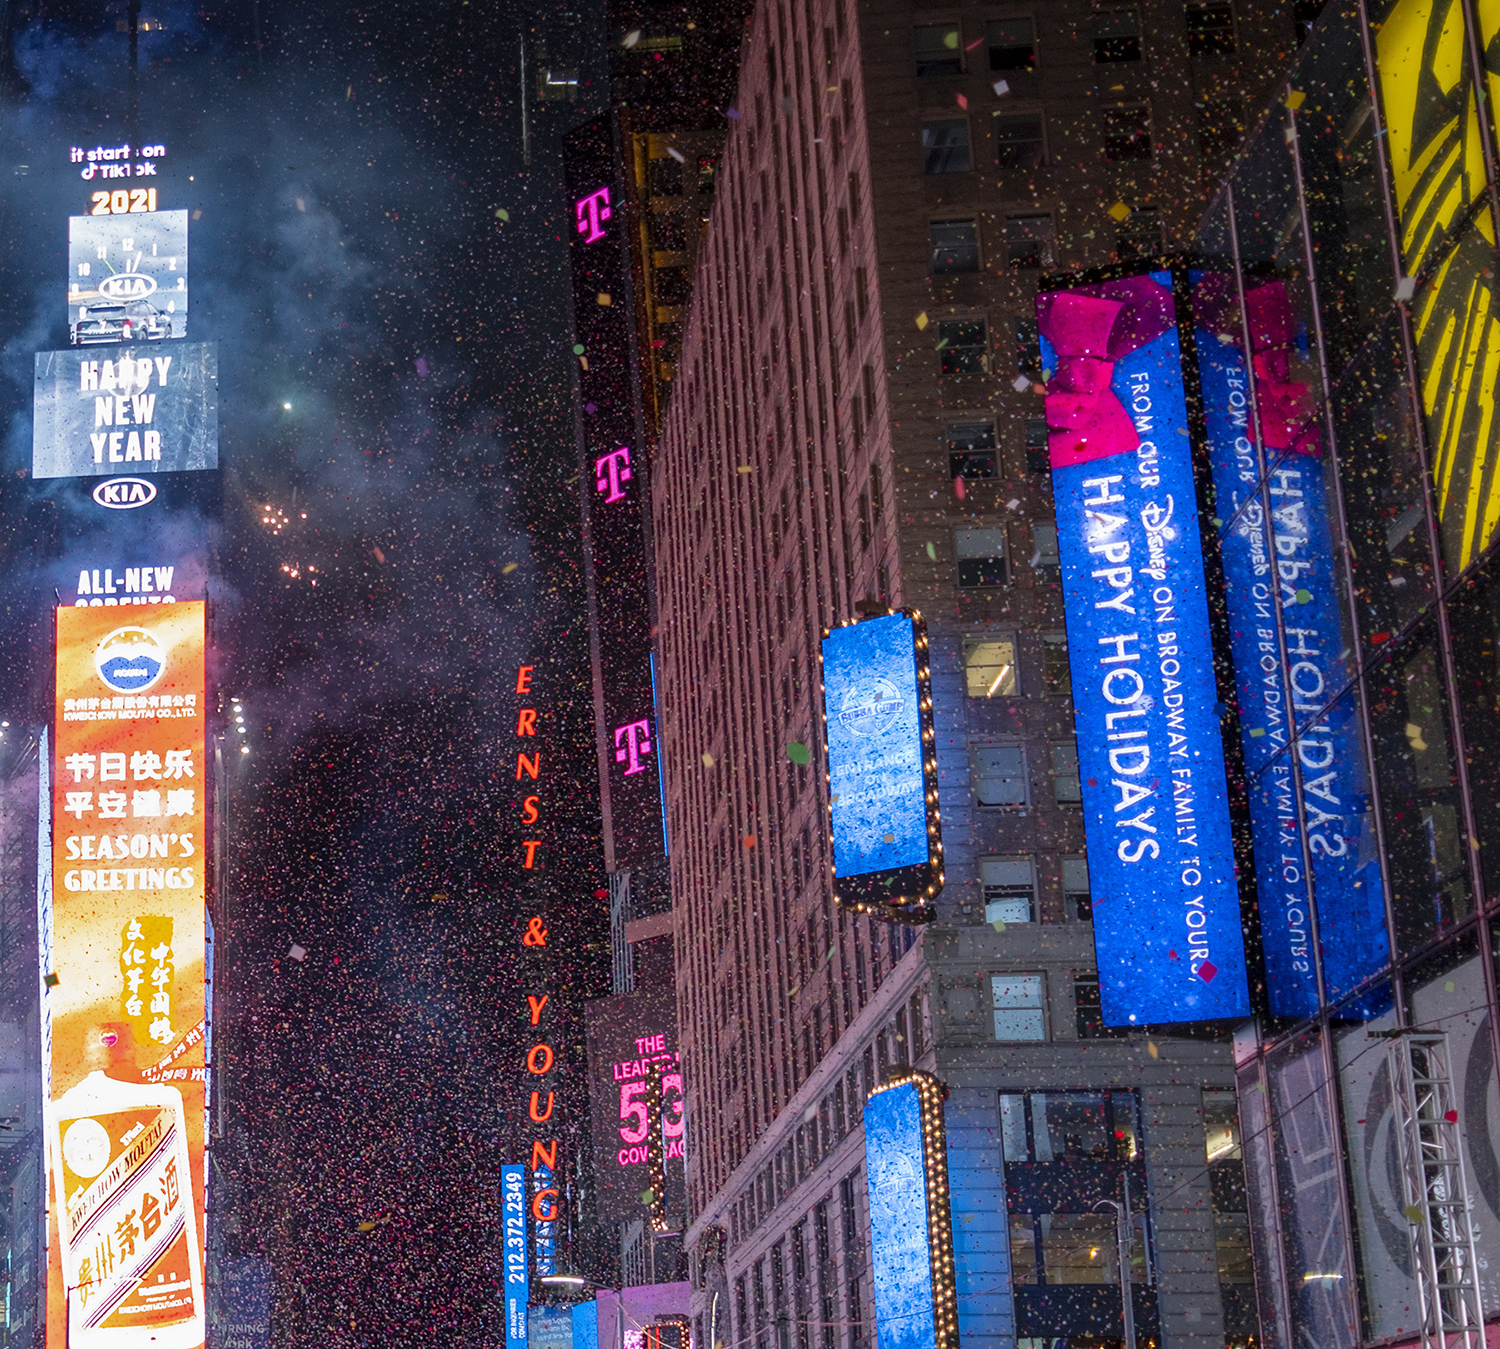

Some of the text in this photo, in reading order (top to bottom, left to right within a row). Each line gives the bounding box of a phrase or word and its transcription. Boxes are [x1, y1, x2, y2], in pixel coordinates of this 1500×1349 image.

[143, 144, 165, 158] on
[92, 188, 157, 215] 2021
[108, 278, 147, 295] KIA
[80, 356, 172, 392] HAPPY
[95, 394, 156, 427] NEW
[1131, 372, 1151, 430] FROM
[90, 430, 161, 464] YEAR
[1139, 442, 1160, 491] OUR
[104, 485, 146, 502] KIA
[77, 566, 174, 595] ALL-NEW
[1154, 588, 1173, 621] ON
[1083, 475, 1161, 863] HAPPY HOLIDAYS
[1156, 632, 1187, 760] BROADWAY
[65, 749, 195, 782] 节日快乐
[64, 789, 195, 820] 平安健康
[1171, 768, 1196, 847] FAMILY
[65, 833, 195, 861] SEASON'S
[64, 867, 195, 893] GREETINGS
[1181, 858, 1202, 887] TO
[515, 665, 559, 1221] ERNST & YOUNG
[635, 1034, 666, 1052] THE
[507, 1171, 525, 1284] 212.372.2349
